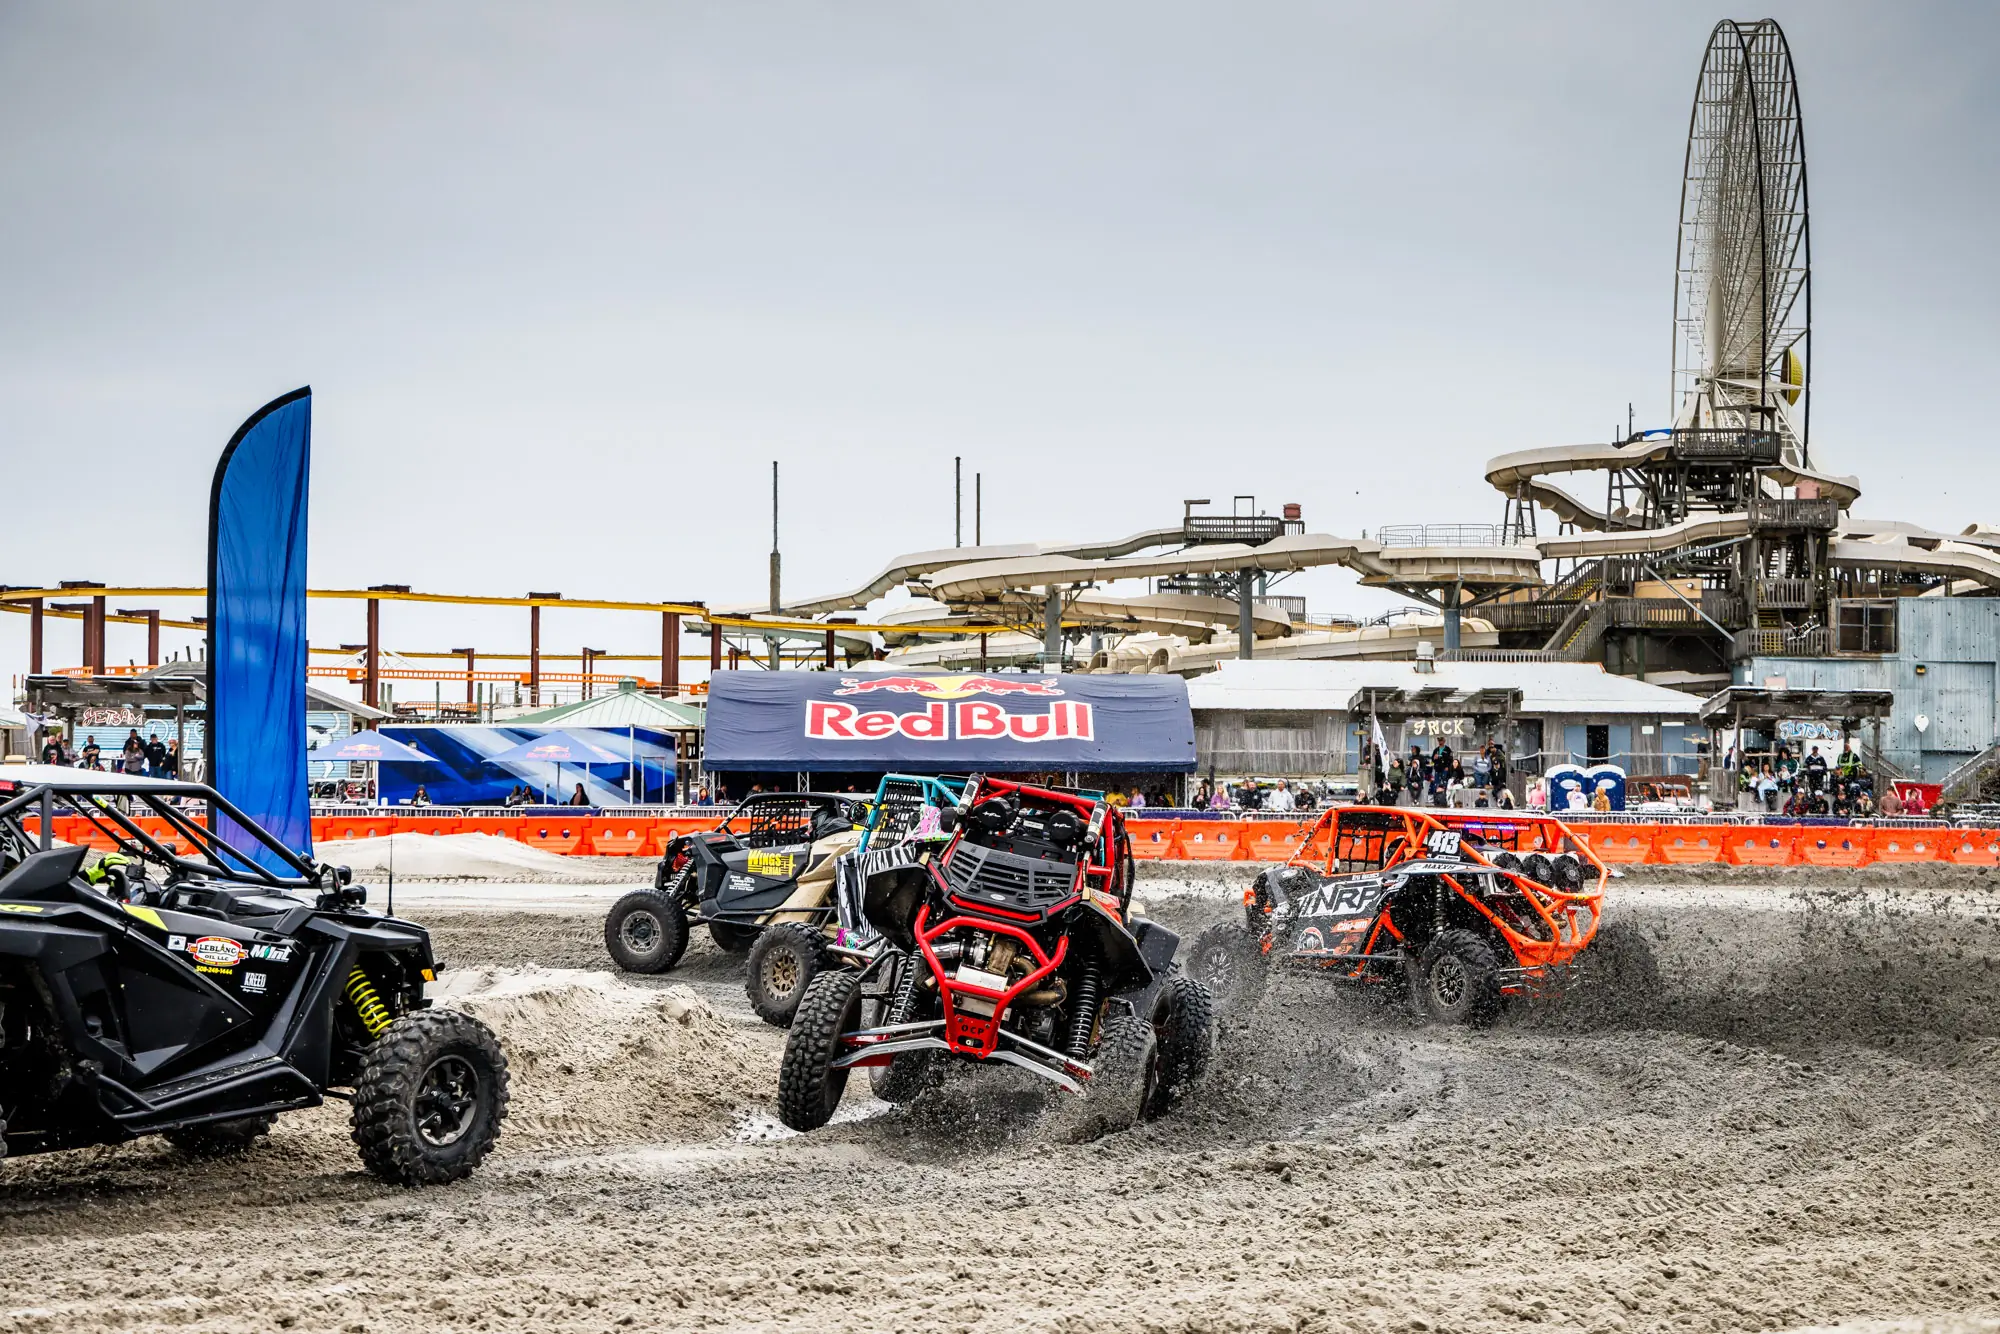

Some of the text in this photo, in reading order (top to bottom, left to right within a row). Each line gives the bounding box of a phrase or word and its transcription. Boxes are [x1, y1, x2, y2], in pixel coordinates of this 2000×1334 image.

[82, 707, 144, 727] JETSAM
[805, 701, 1094, 741] Red Bull
[1428, 830, 1460, 855] 413
[1308, 881, 1381, 917] NRP
[244, 972, 267, 987] KREED
[961, 1024, 985, 1035] OCP
